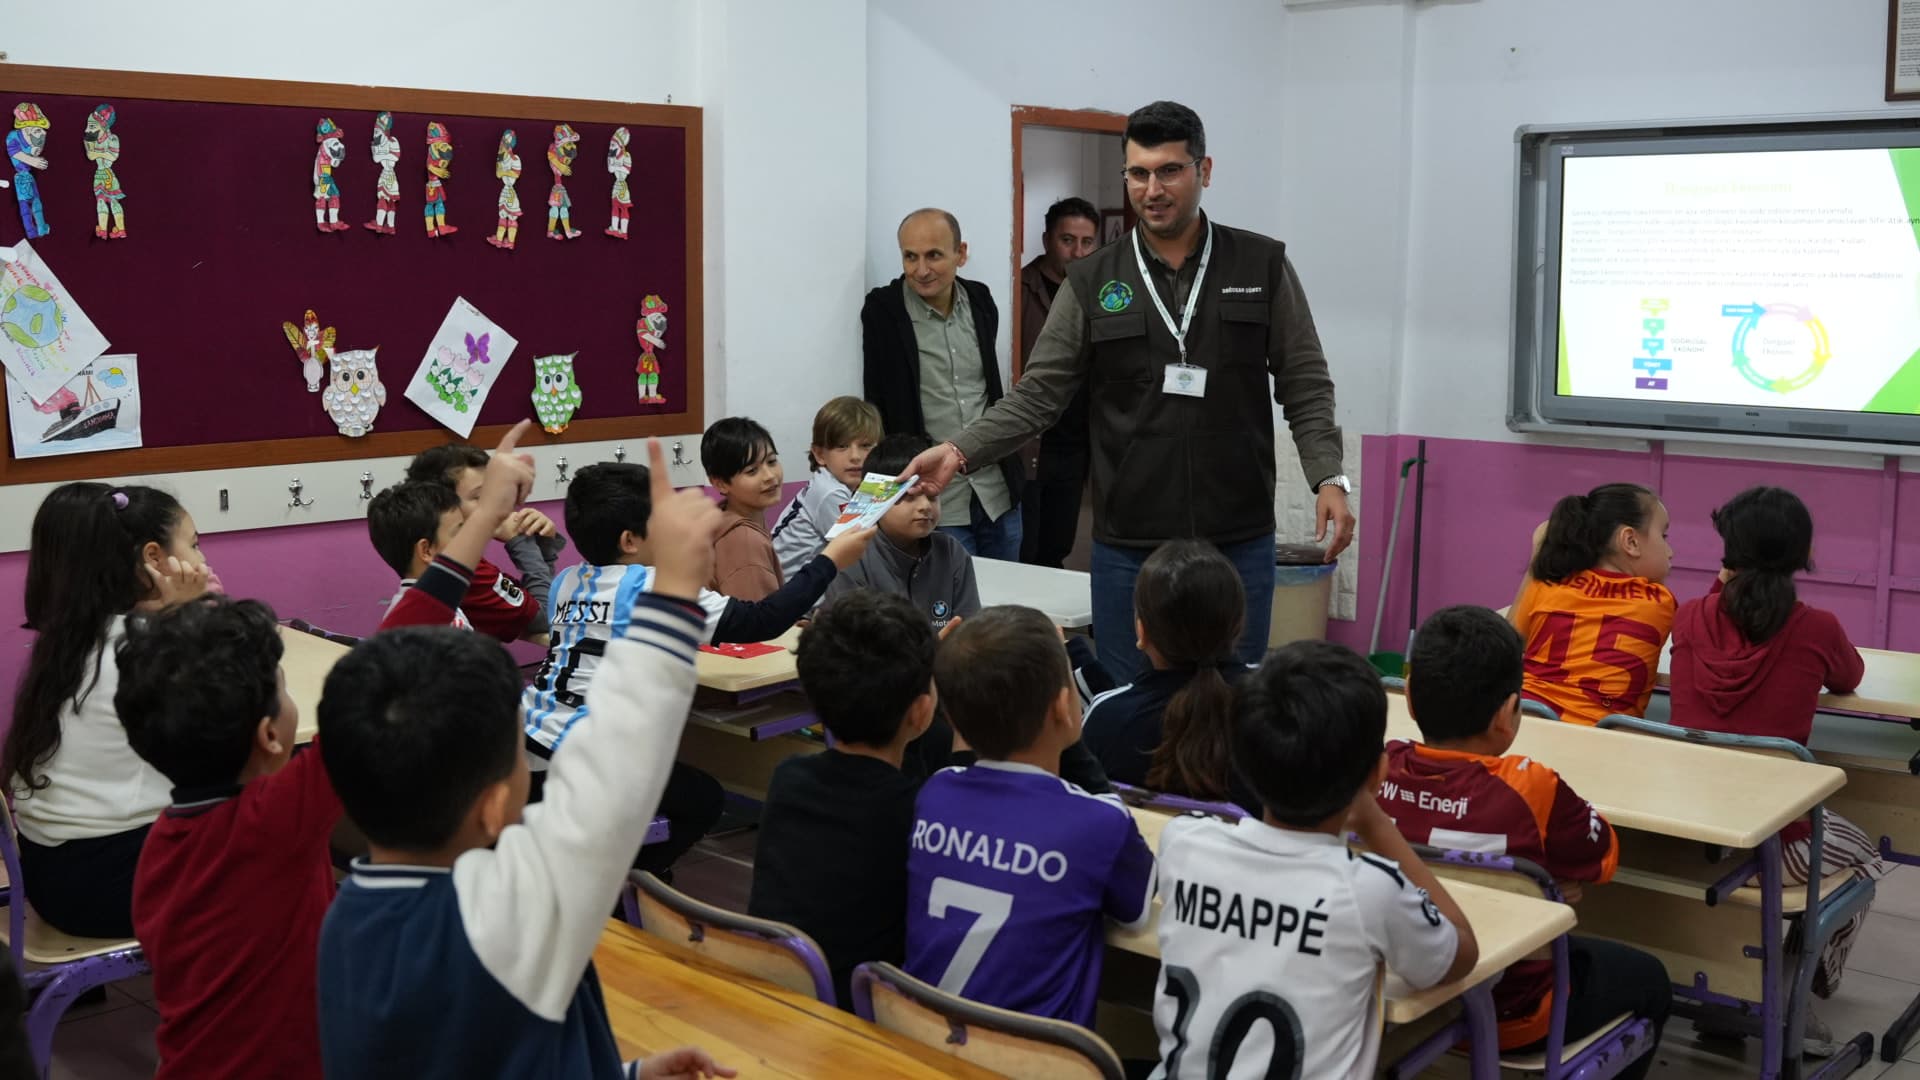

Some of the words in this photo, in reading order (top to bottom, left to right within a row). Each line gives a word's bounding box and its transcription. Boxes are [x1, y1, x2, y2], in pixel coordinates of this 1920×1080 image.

[552, 600, 611, 625] MESSI
[1523, 610, 1661, 711] 45
[1418, 791, 1469, 820] Enerji
[912, 818, 1069, 883] RONALDO
[927, 876, 1015, 996] 7
[1175, 880, 1329, 957] MBAPPÉ
